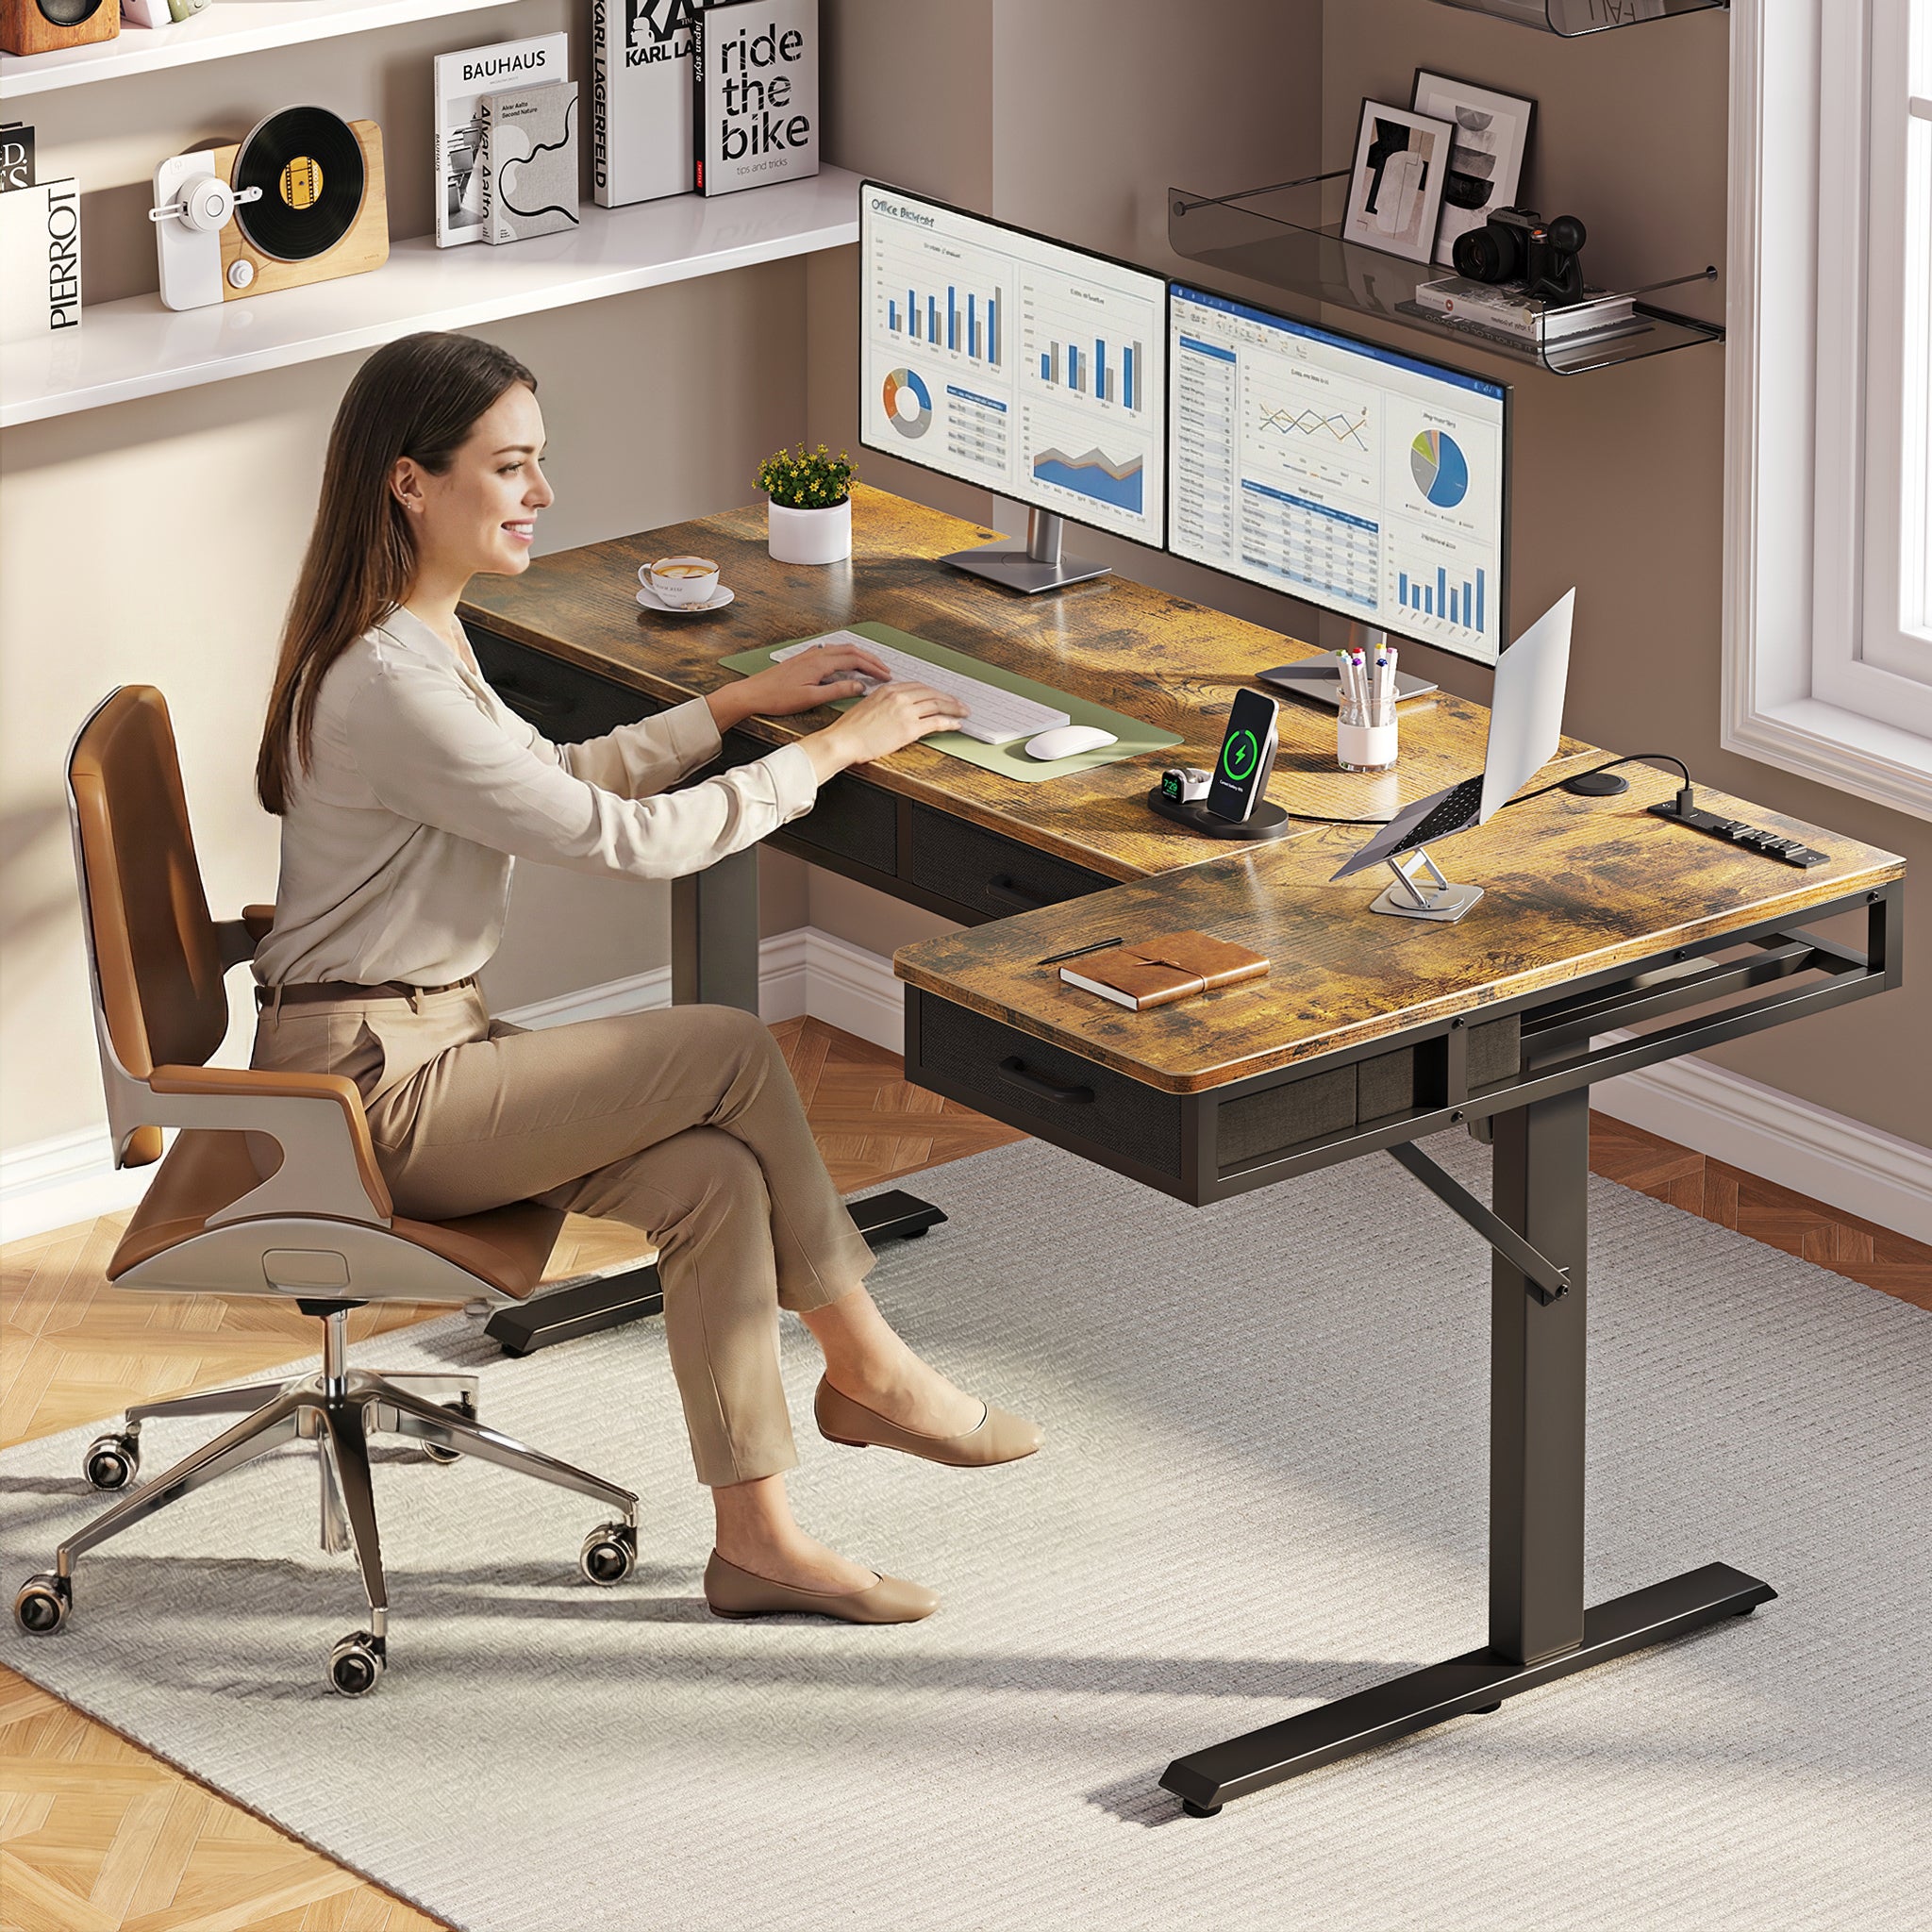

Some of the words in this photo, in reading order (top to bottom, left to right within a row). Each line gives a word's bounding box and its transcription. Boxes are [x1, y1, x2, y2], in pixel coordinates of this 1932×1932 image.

[594, 0, 605, 54] KARL
[694, 20, 703, 53] Japan
[722, 23, 804, 74] ride
[463, 50, 546, 81] BAUHAUS
[625, 44, 672, 68] KARL
[694, 56, 704, 82] style
[722, 72, 791, 116] the
[594, 58, 606, 189] LAGERFELD
[722, 111, 810, 161] bike
[0, 142, 28, 168] D.
[752, 163, 767, 172] and
[482, 165, 492, 219] Aalto
[47, 188, 79, 330] PIERROT
